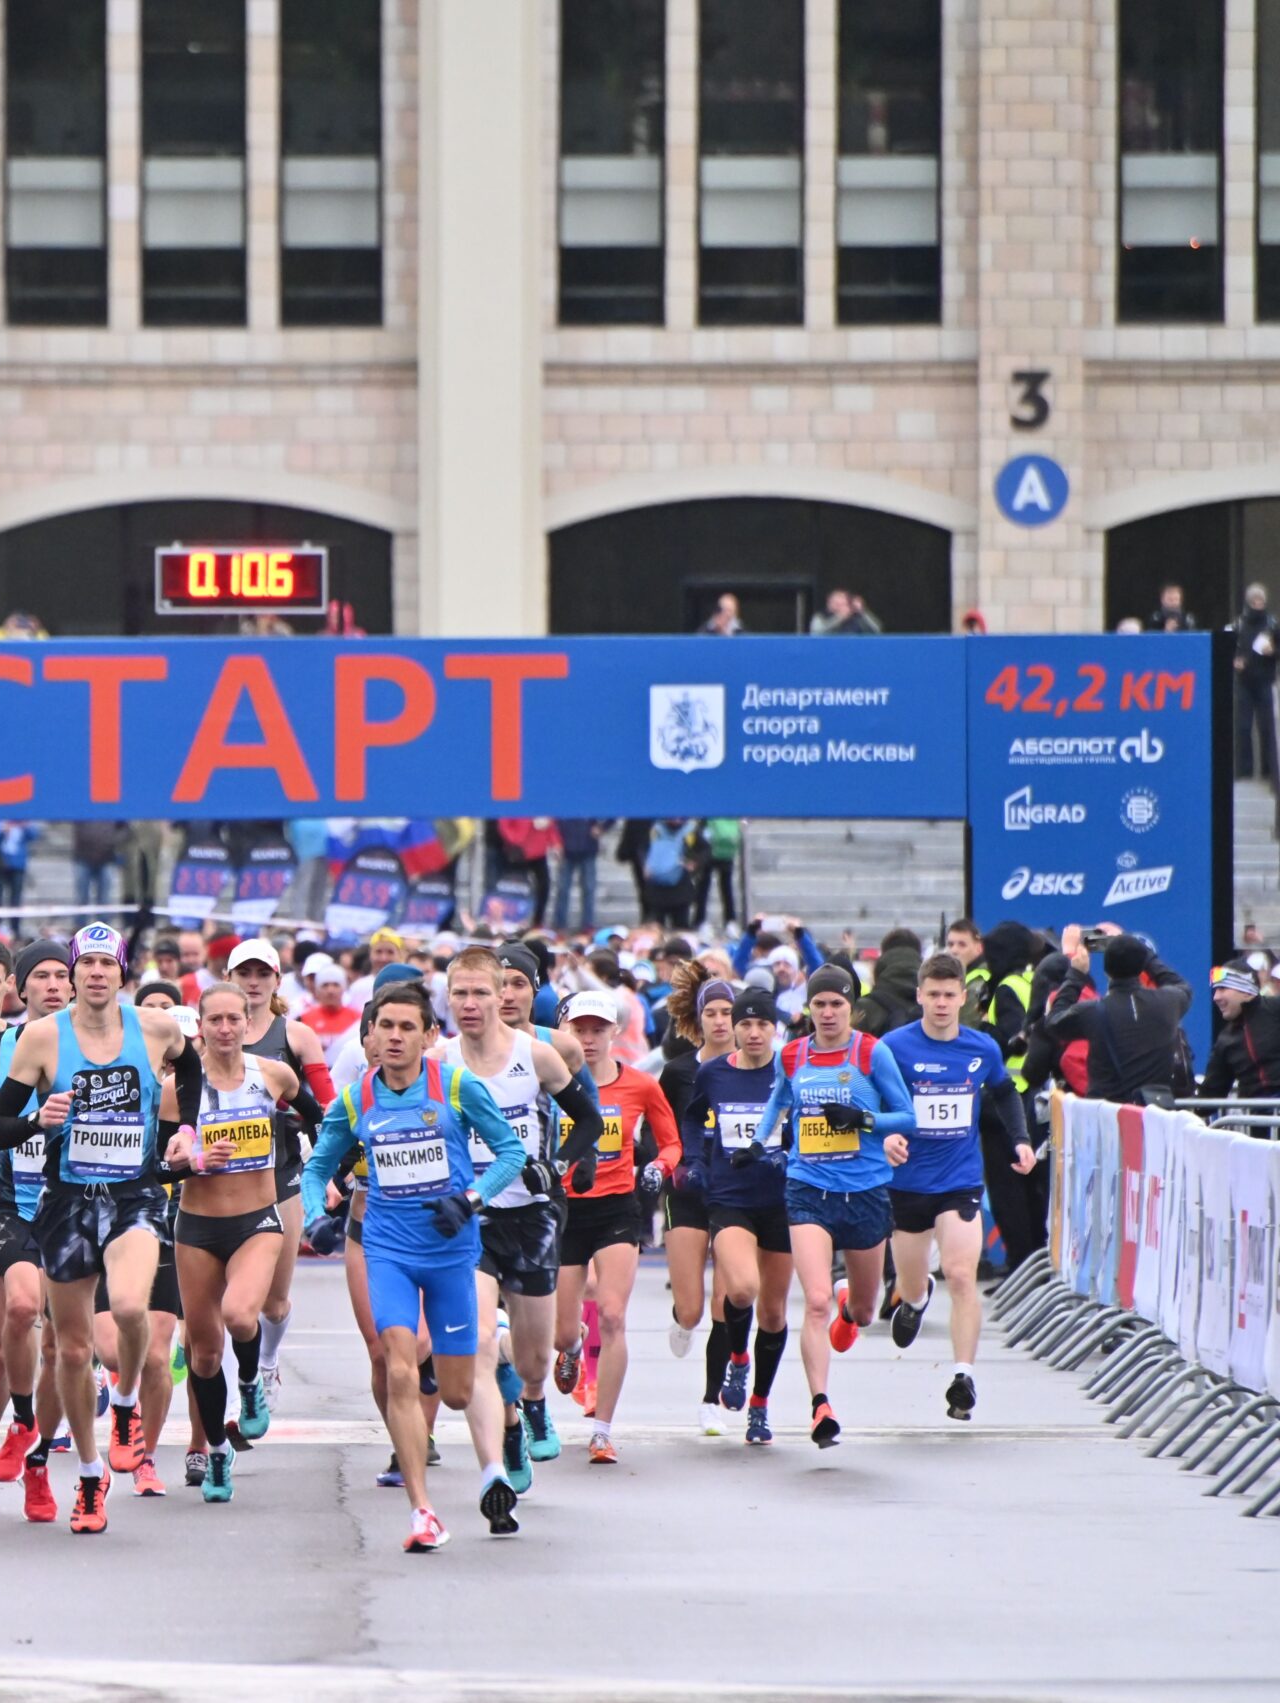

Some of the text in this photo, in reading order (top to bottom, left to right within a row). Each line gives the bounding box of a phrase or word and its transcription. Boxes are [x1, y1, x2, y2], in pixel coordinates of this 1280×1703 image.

[1010, 371, 1050, 431] 3
[1012, 463, 1051, 511] A
[742, 684, 890, 711] Департамент
[984, 664, 1195, 718] 42,2 КМ
[742, 715, 819, 739] спорта
[742, 739, 916, 767] города Москвы
[1009, 738, 1117, 755] АБСОЛЮТ
[1010, 804, 1087, 824] INGRAD
[1028, 872, 1085, 896] asics
[1113, 874, 1168, 896] Active
[800, 1087, 852, 1104] RUSSIA
[928, 1103, 958, 1121] 151
[73, 1129, 141, 1149] ТРОШКИН
[734, 1122, 760, 1139] 15
[375, 1145, 444, 1168] МАКСИМОВ
